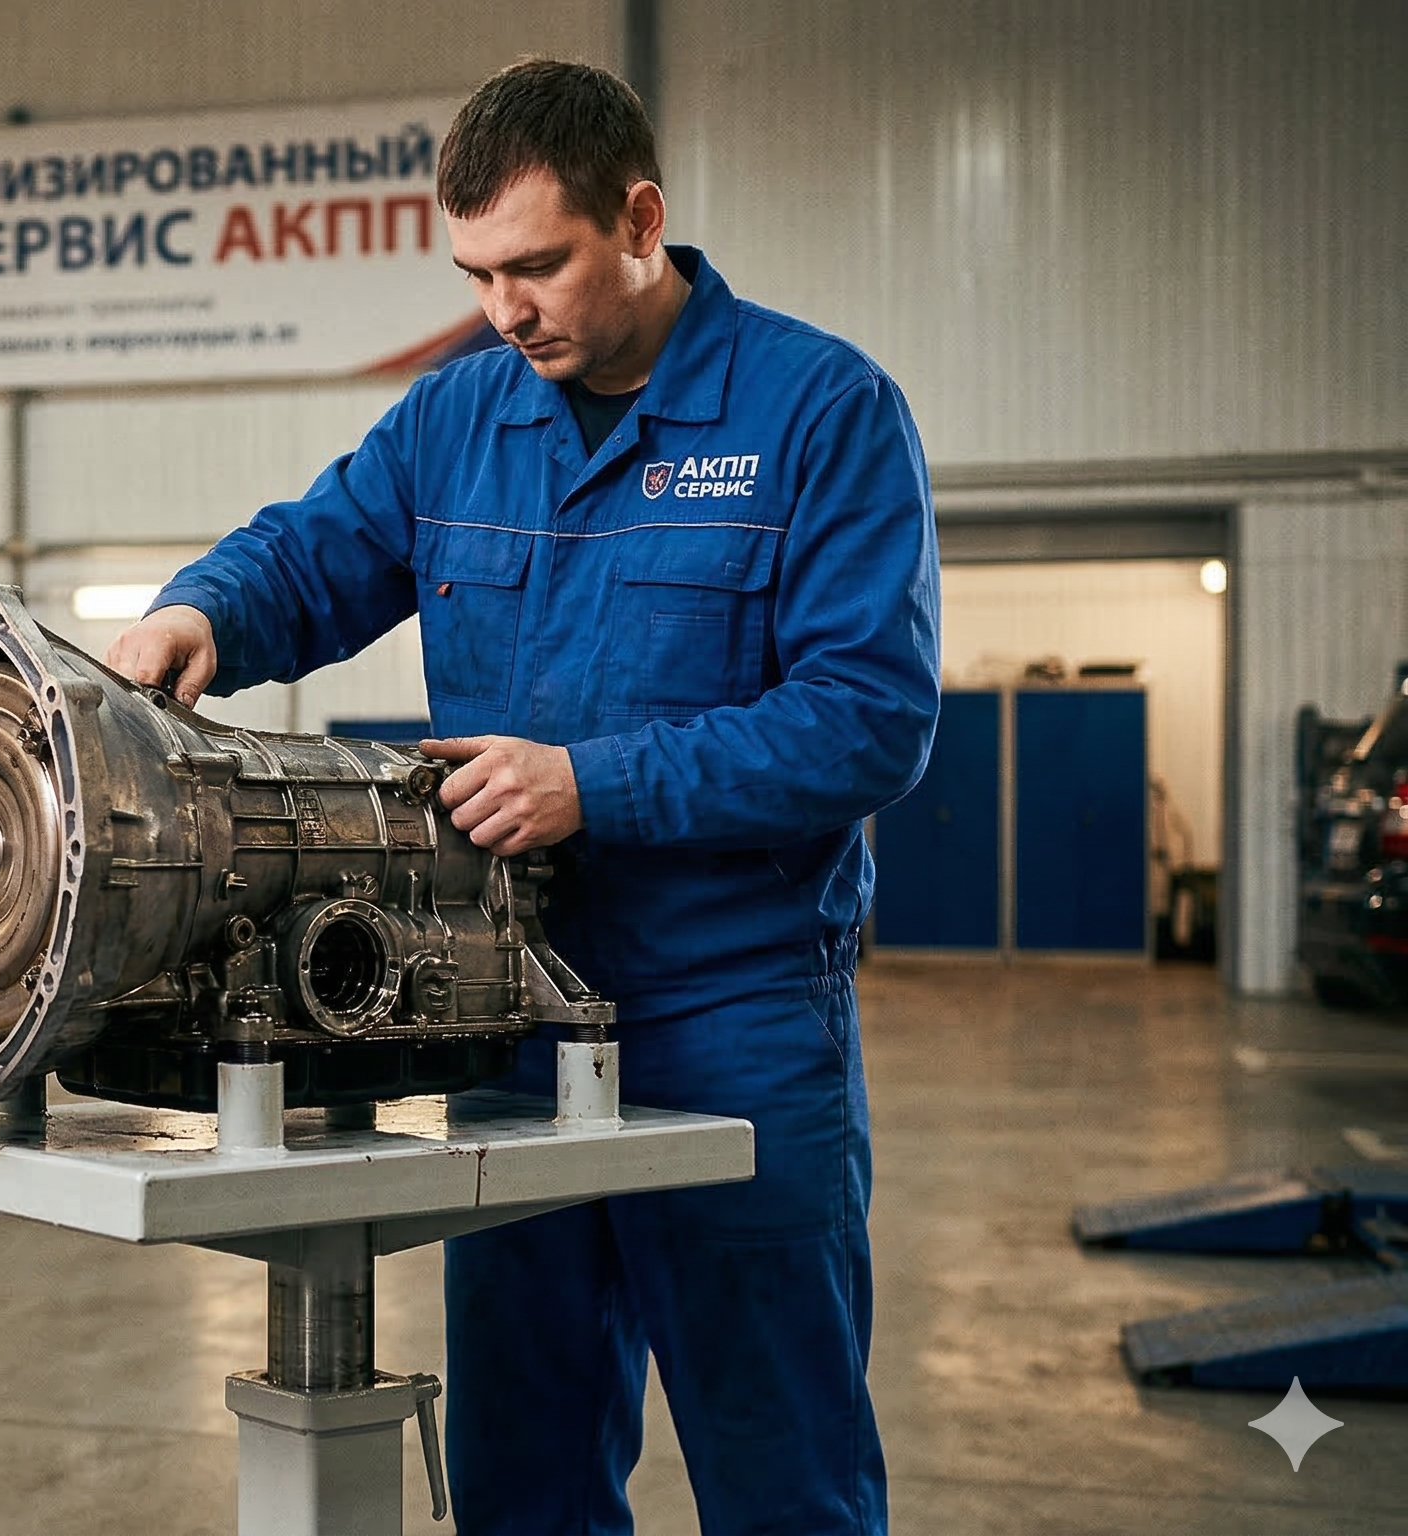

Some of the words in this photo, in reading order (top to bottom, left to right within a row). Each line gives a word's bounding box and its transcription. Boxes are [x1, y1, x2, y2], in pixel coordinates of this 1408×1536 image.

[213, 194, 433, 265] АКПП
[677, 455, 759, 479] АКПП
[674, 480, 754, 498] СЕРВИС
